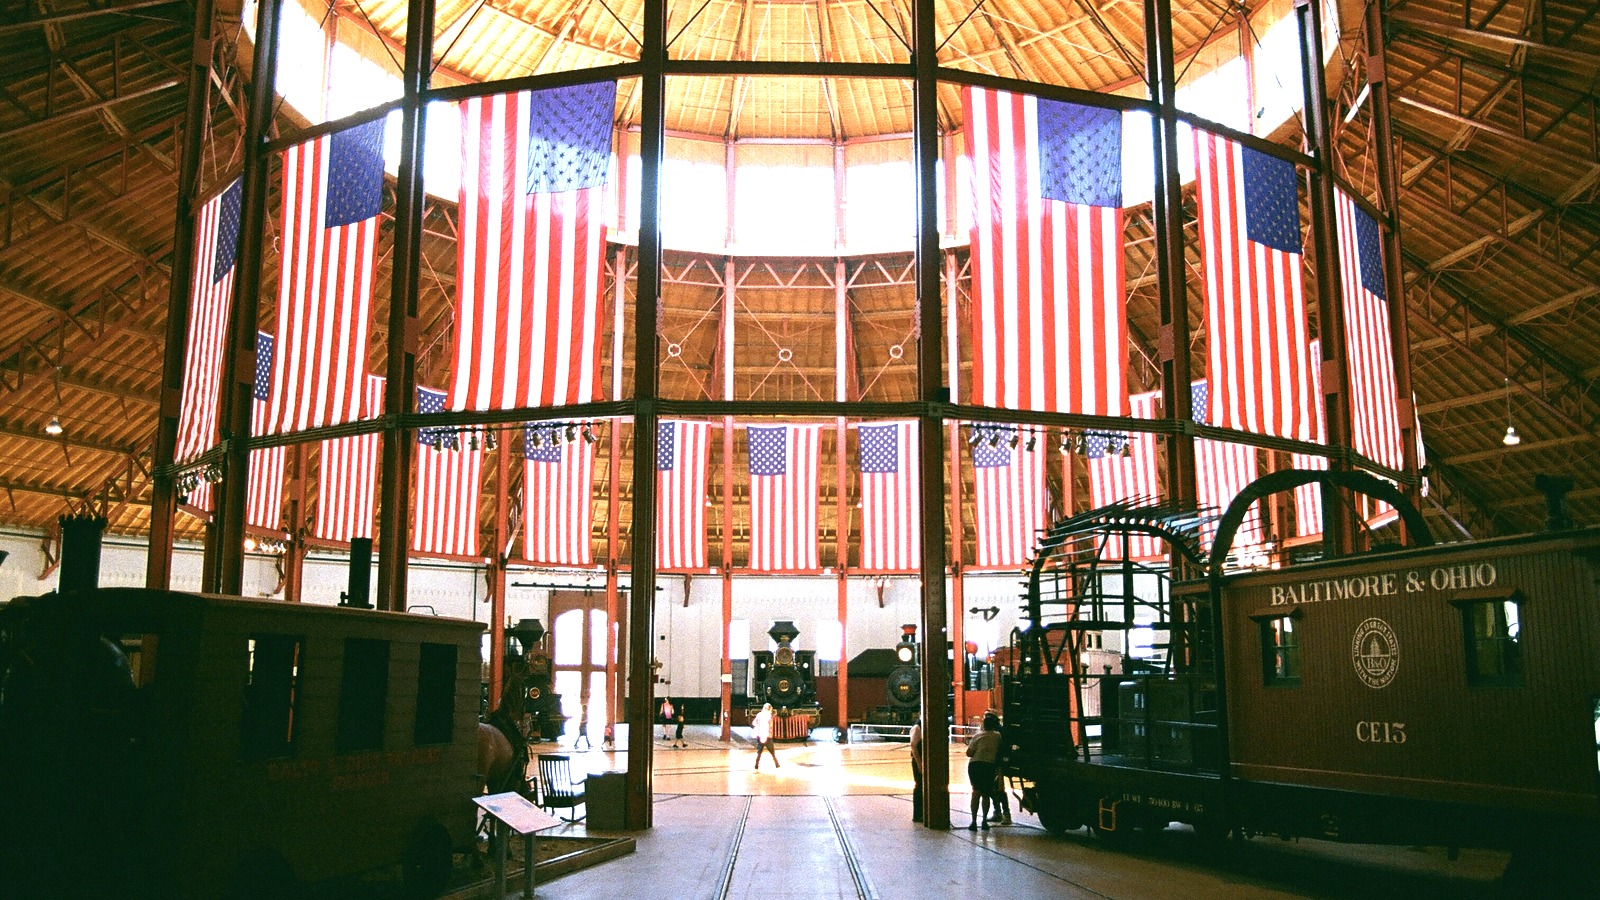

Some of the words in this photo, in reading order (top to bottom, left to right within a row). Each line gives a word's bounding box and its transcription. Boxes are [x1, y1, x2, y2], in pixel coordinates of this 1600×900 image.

[1270, 573, 1397, 606] BALTIMORE
[1405, 571, 1425, 593] &
[1430, 563, 1497, 591] OHIO
